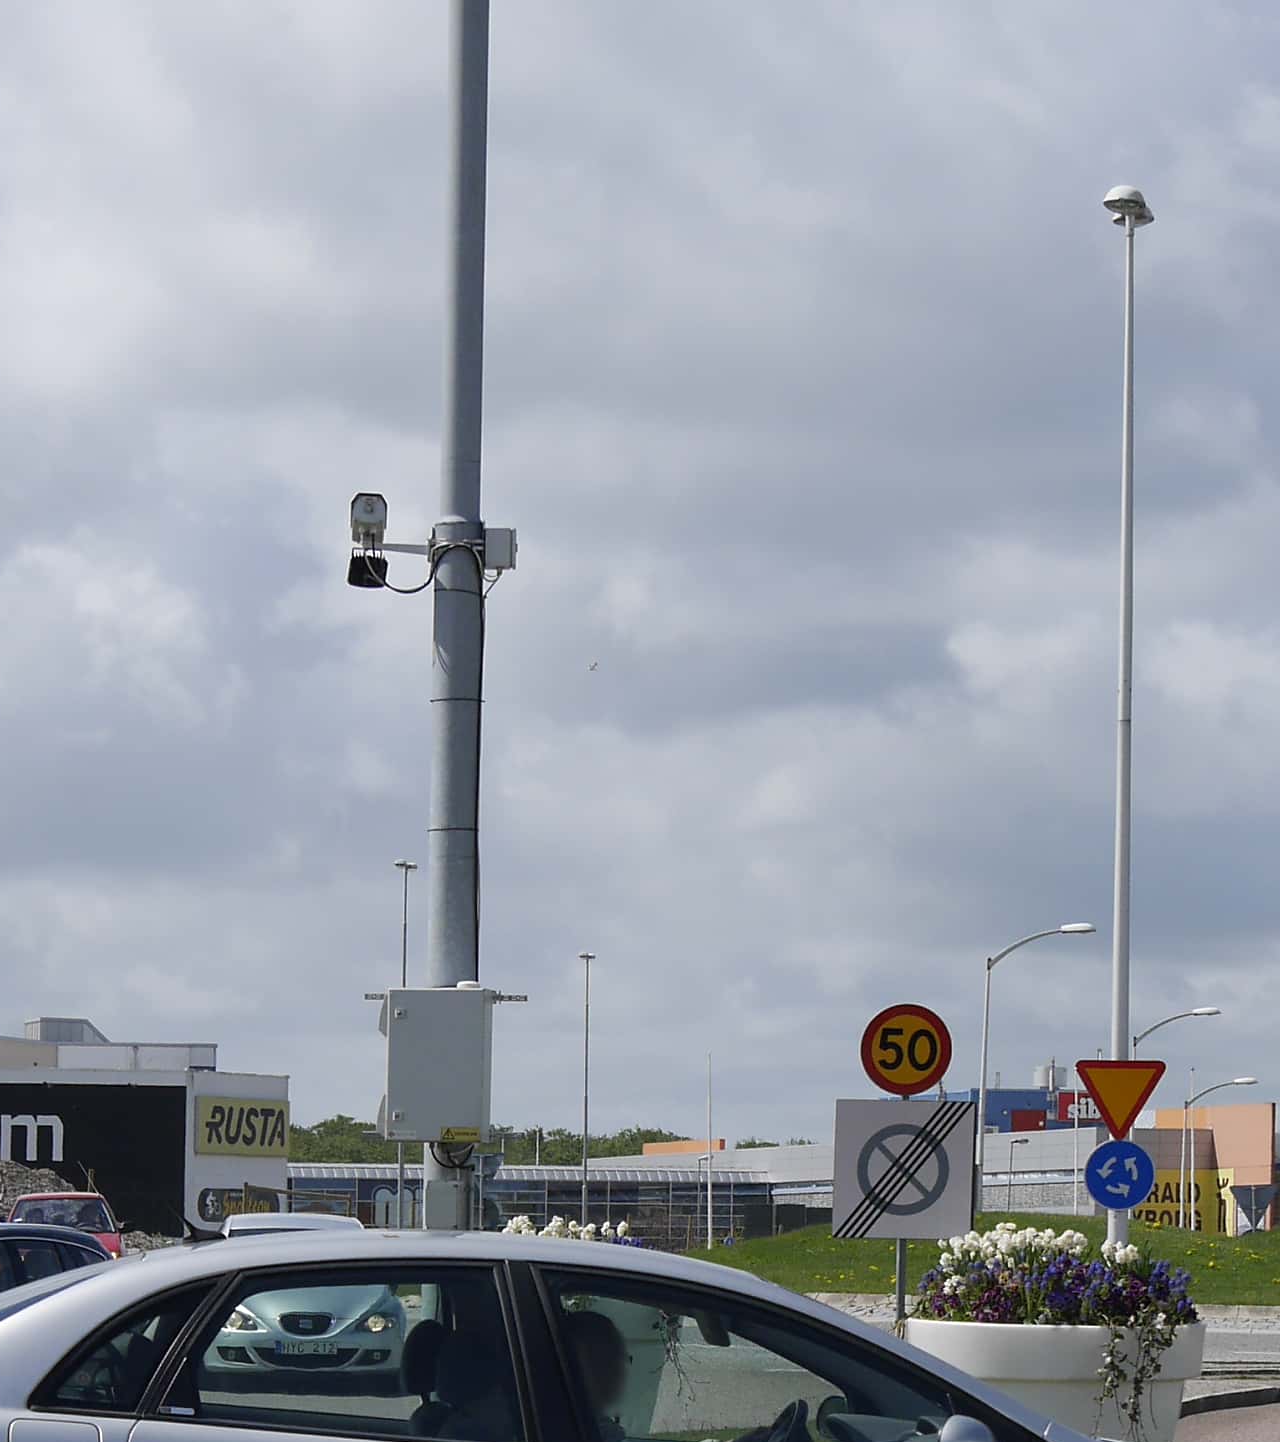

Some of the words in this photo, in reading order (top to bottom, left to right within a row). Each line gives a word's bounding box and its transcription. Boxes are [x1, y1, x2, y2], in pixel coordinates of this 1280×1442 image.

[878, 1028, 938, 1071] 50
[205, 1105, 285, 1147] RUSTA
[1067, 1097, 1102, 1119] sib
